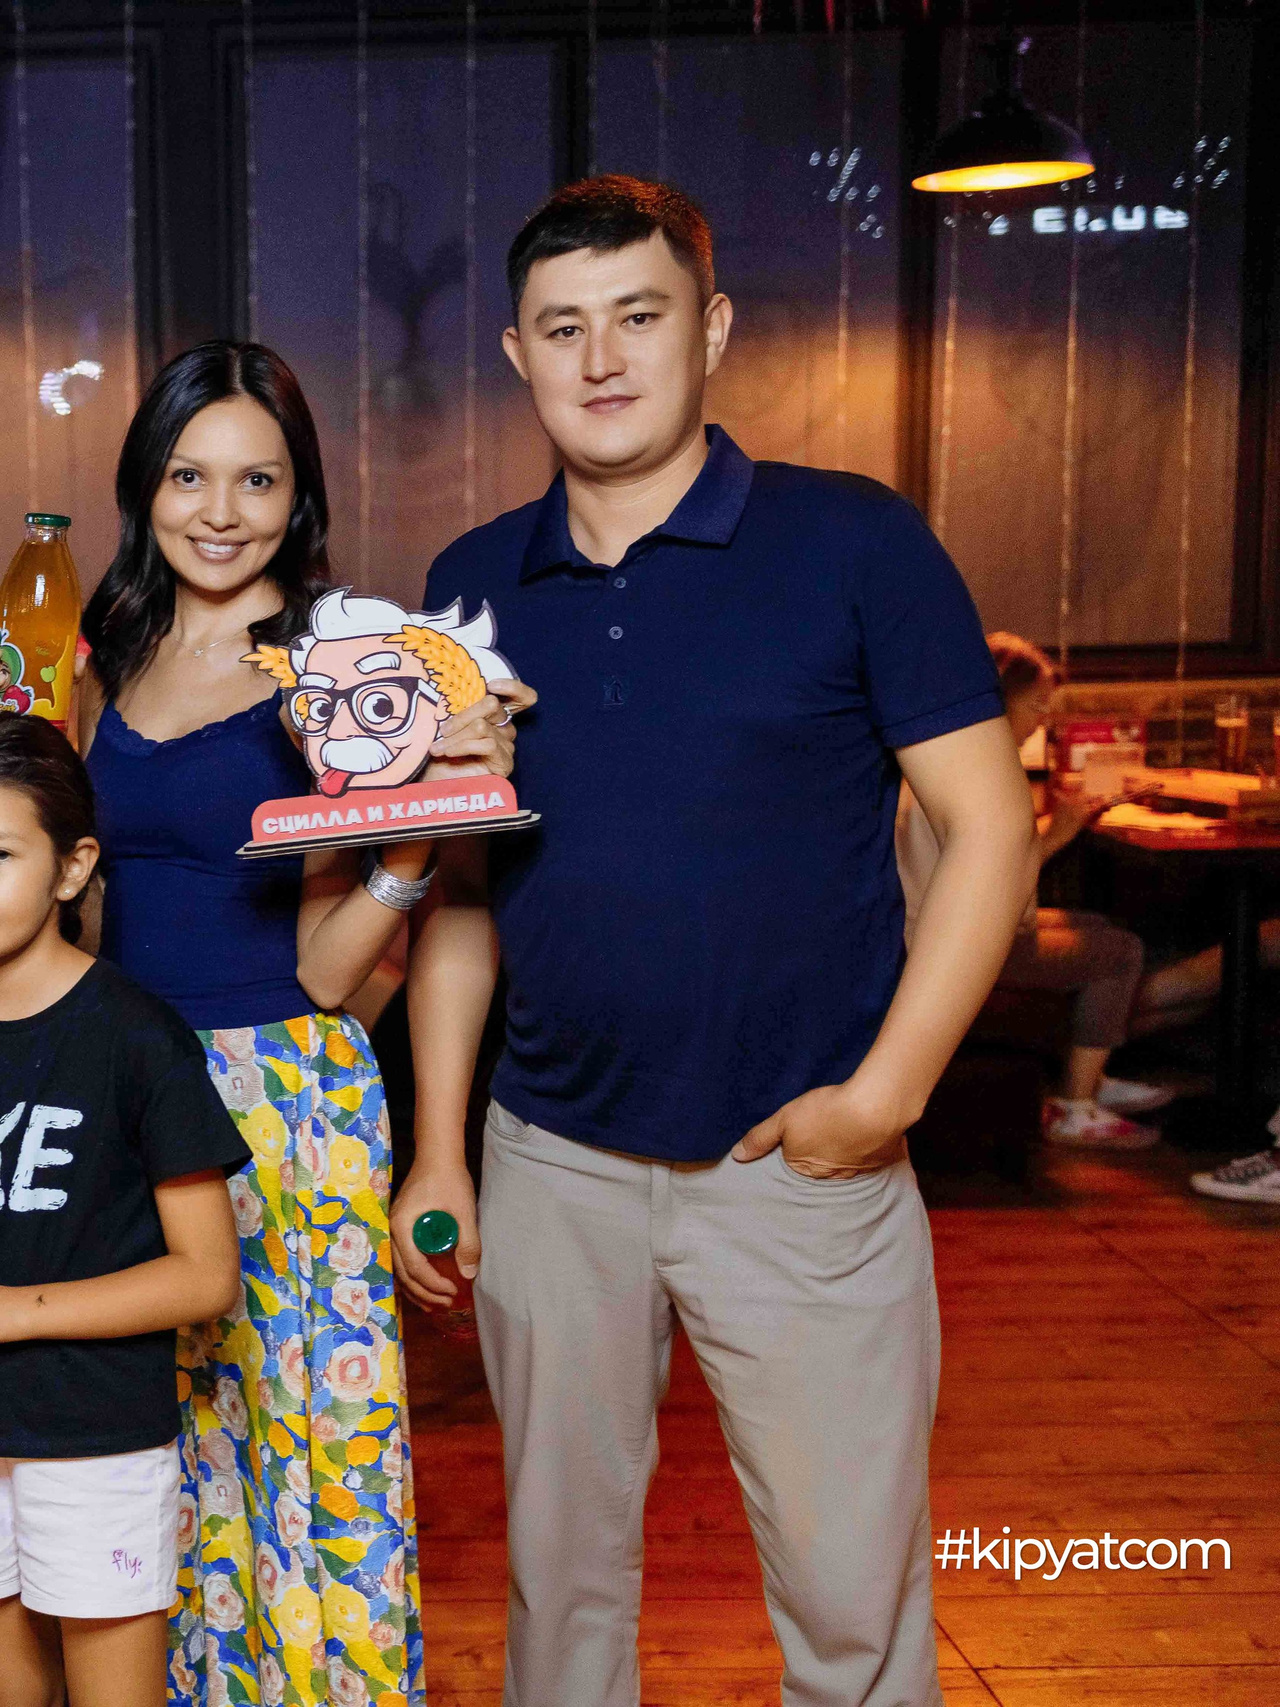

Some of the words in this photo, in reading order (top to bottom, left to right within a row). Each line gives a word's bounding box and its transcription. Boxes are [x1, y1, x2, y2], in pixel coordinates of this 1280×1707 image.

[262, 809, 364, 835] СЦИЛЛА
[367, 806, 384, 822] И
[387, 791, 507, 820] ХАРИБДА
